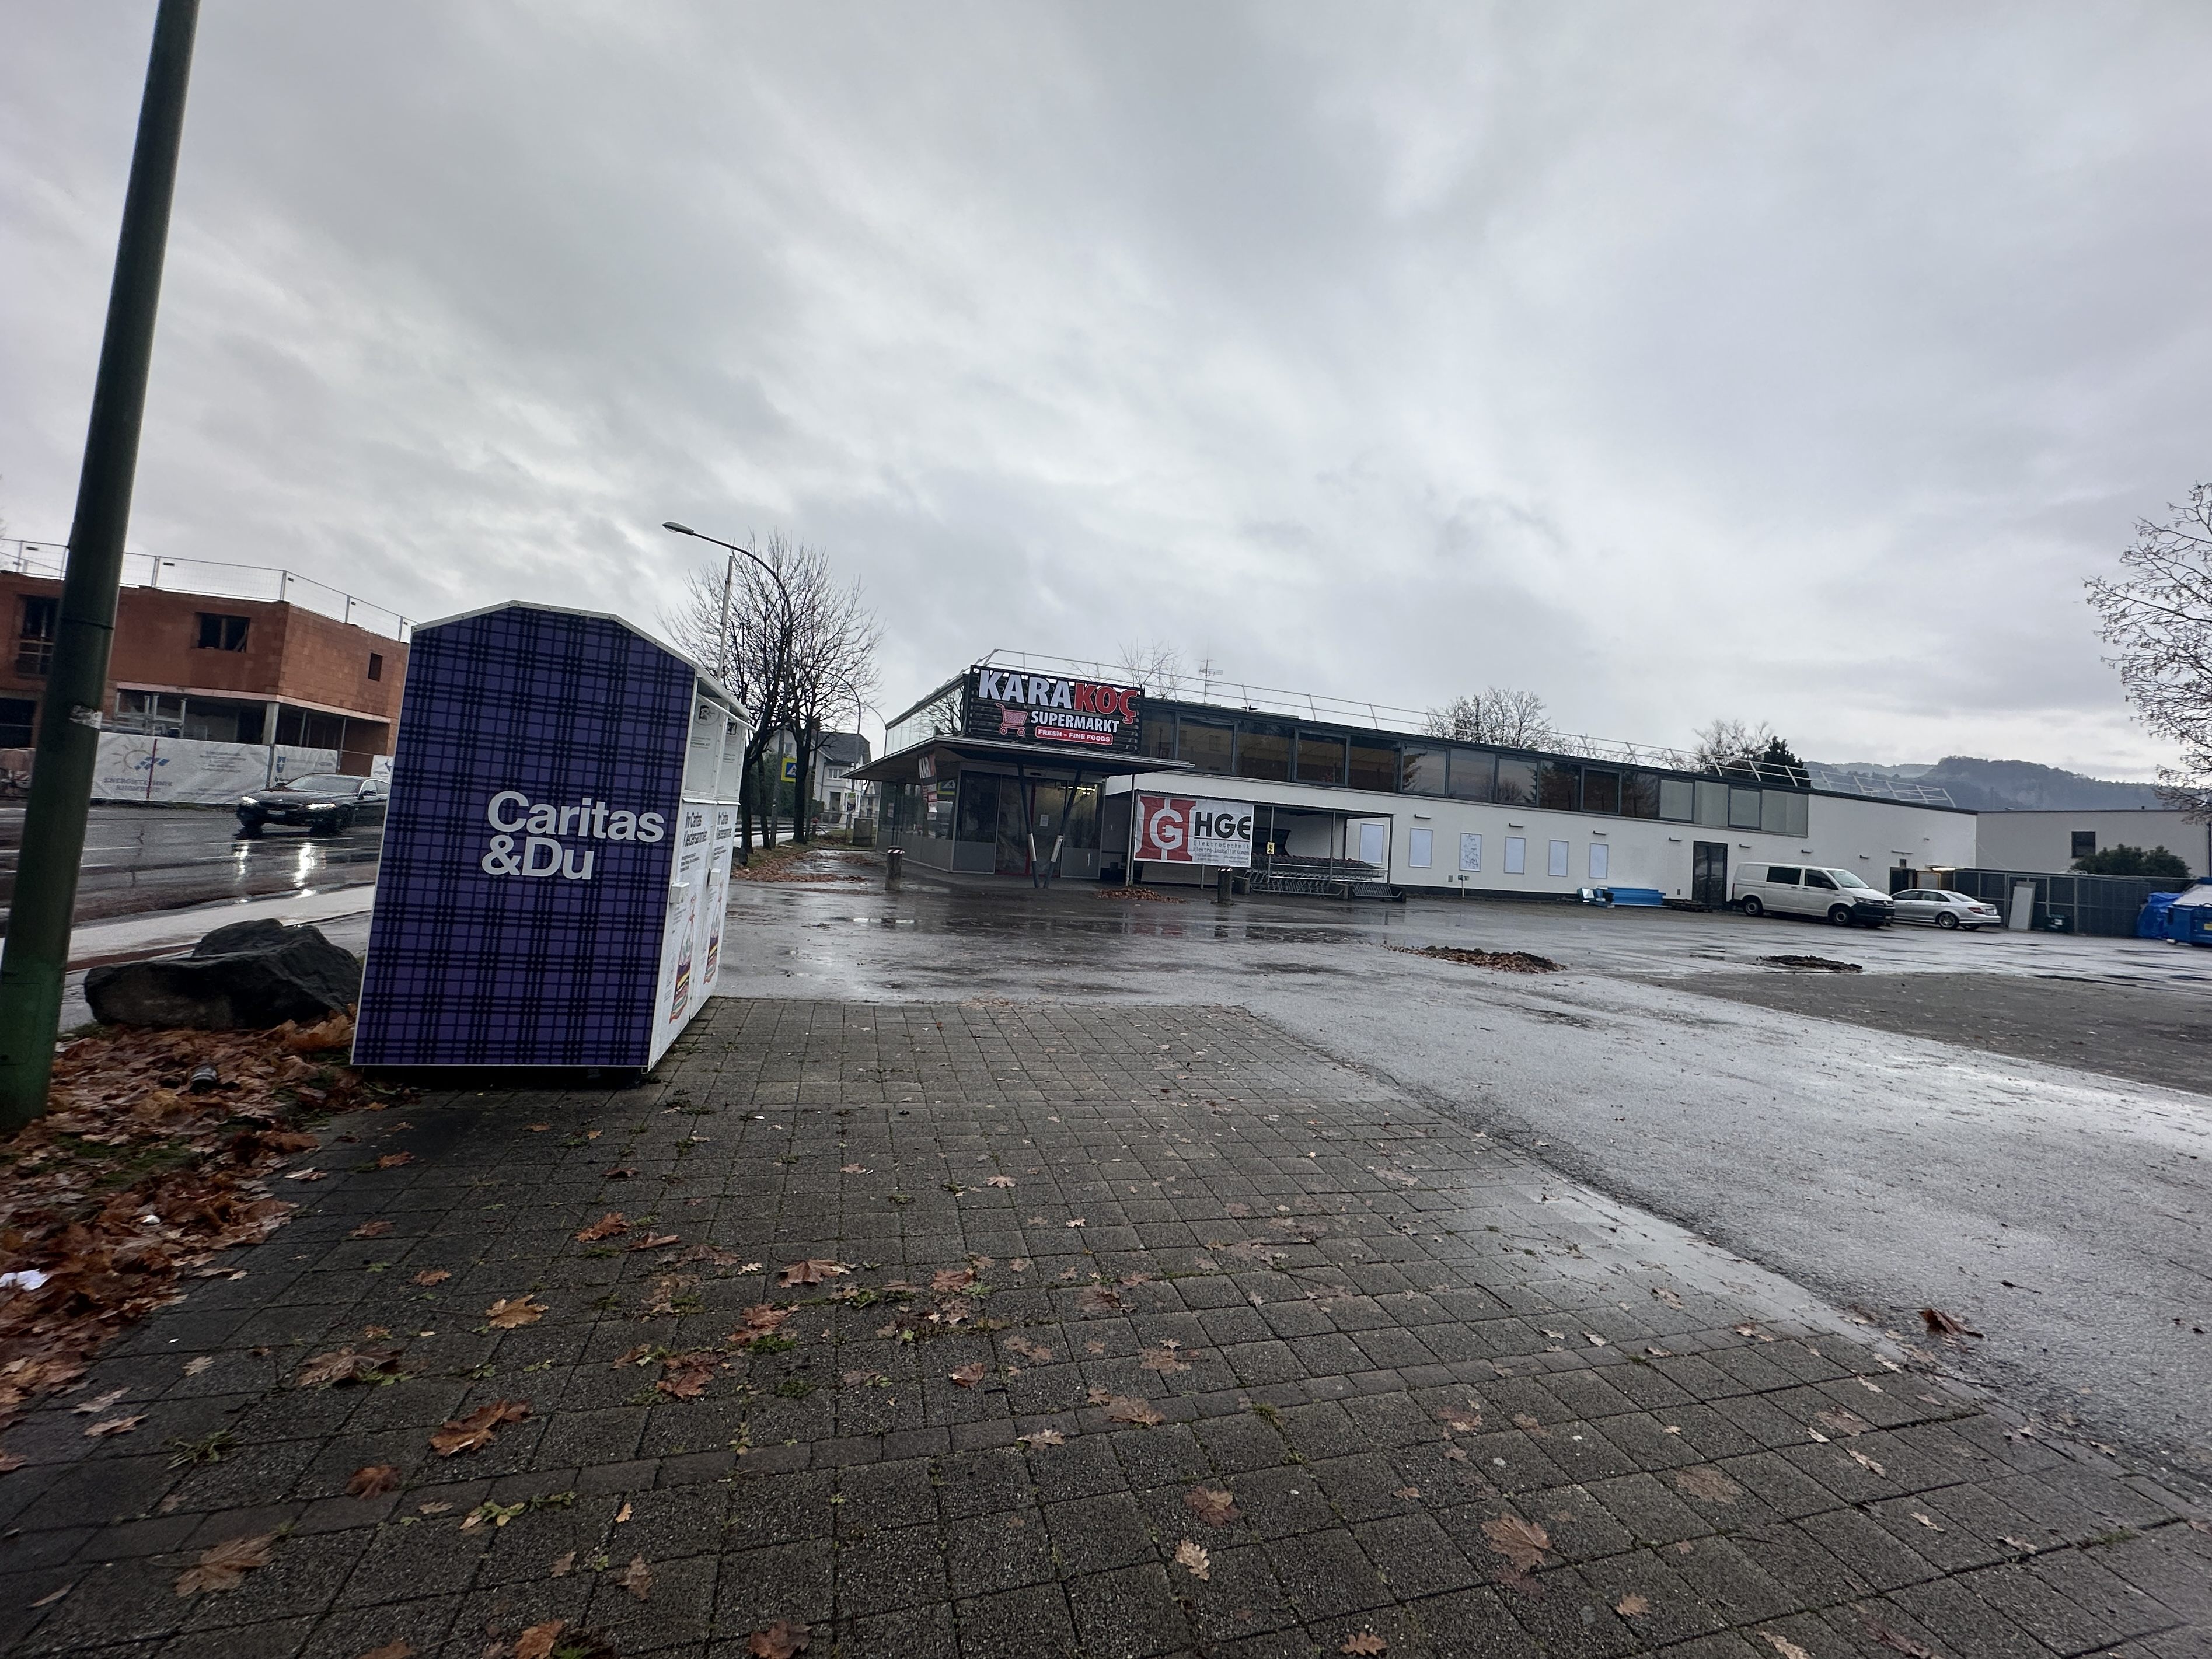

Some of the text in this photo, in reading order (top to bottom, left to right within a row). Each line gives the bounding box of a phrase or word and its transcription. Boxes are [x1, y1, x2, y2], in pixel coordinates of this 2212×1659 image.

[978, 670, 1138, 725] KARAKOÇ
[1031, 710, 1119, 733] SUPERMARKT
[1038, 729, 1062, 738] FRESH
[488, 791, 664, 843] Caritas
[1194, 811, 1251, 840] HGE
[482, 835, 594, 880] &Du
[1193, 840, 1250, 850] Elektrotechnik
